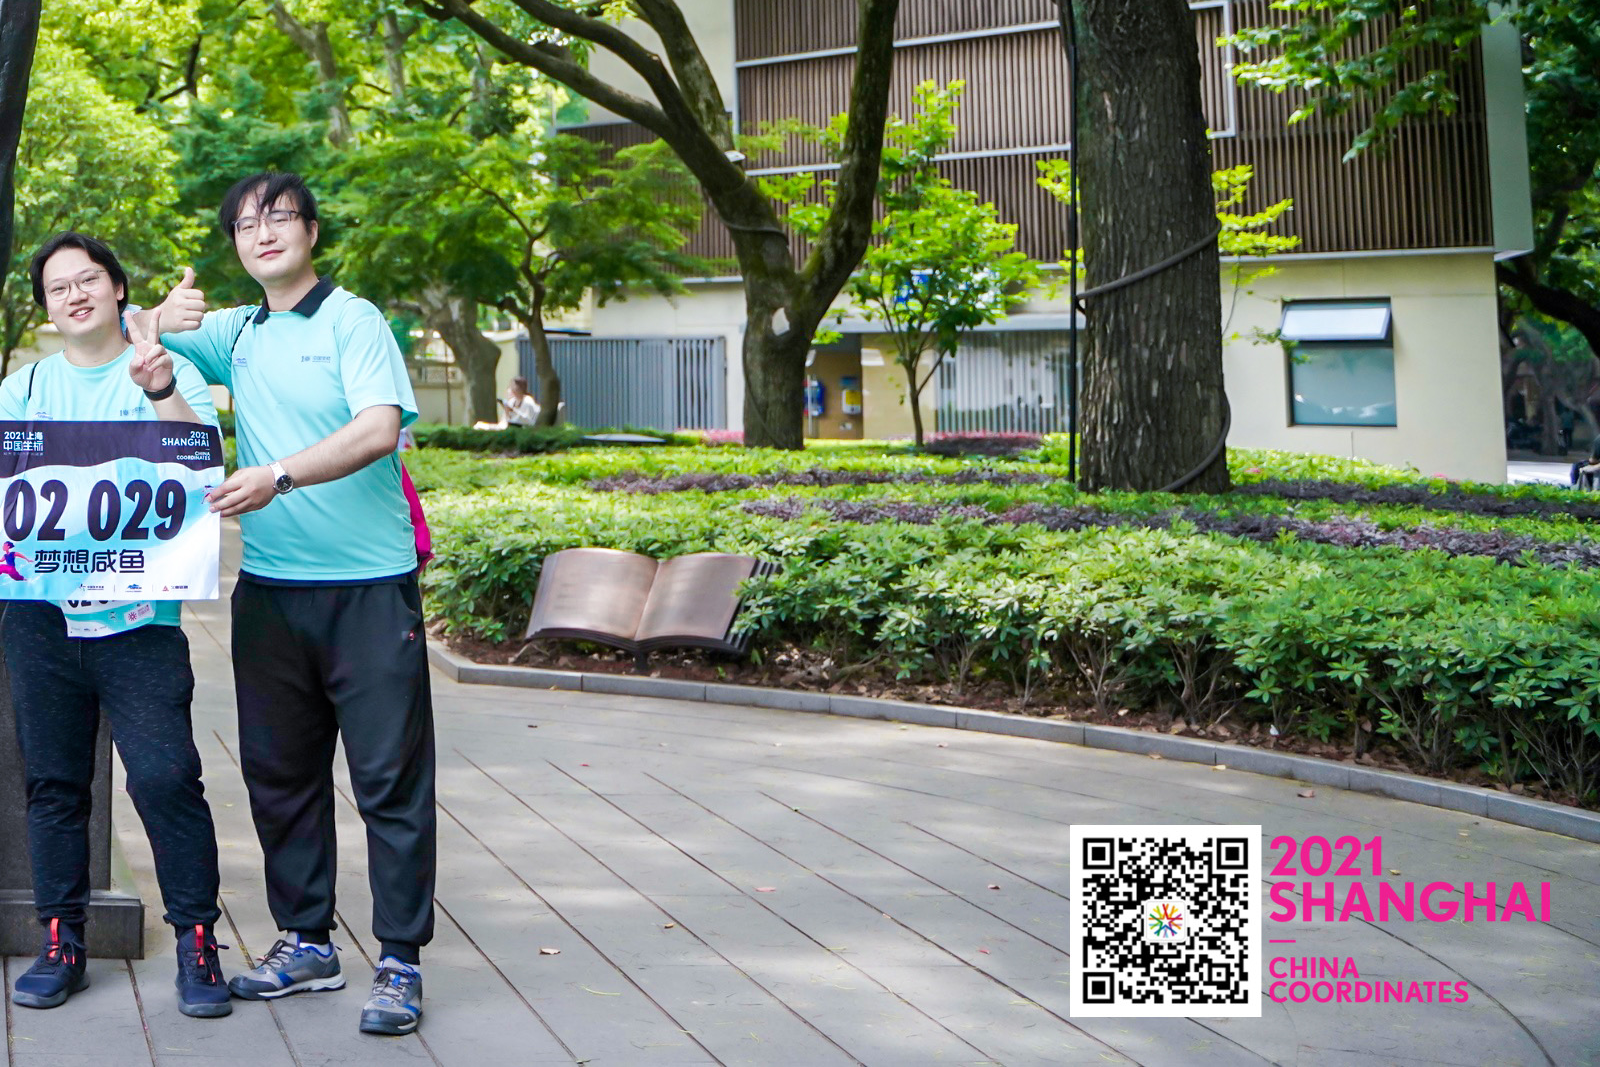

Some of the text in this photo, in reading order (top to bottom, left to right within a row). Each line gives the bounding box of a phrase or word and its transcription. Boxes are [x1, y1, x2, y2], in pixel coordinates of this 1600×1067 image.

[190, 431, 209, 439] 2021
[3, 440, 44, 452] 中国坐标
[162, 437, 209, 447] SHANGHAI
[3, 479, 187, 542] 02 029
[34, 548, 145, 574] 梦想咸鱼
